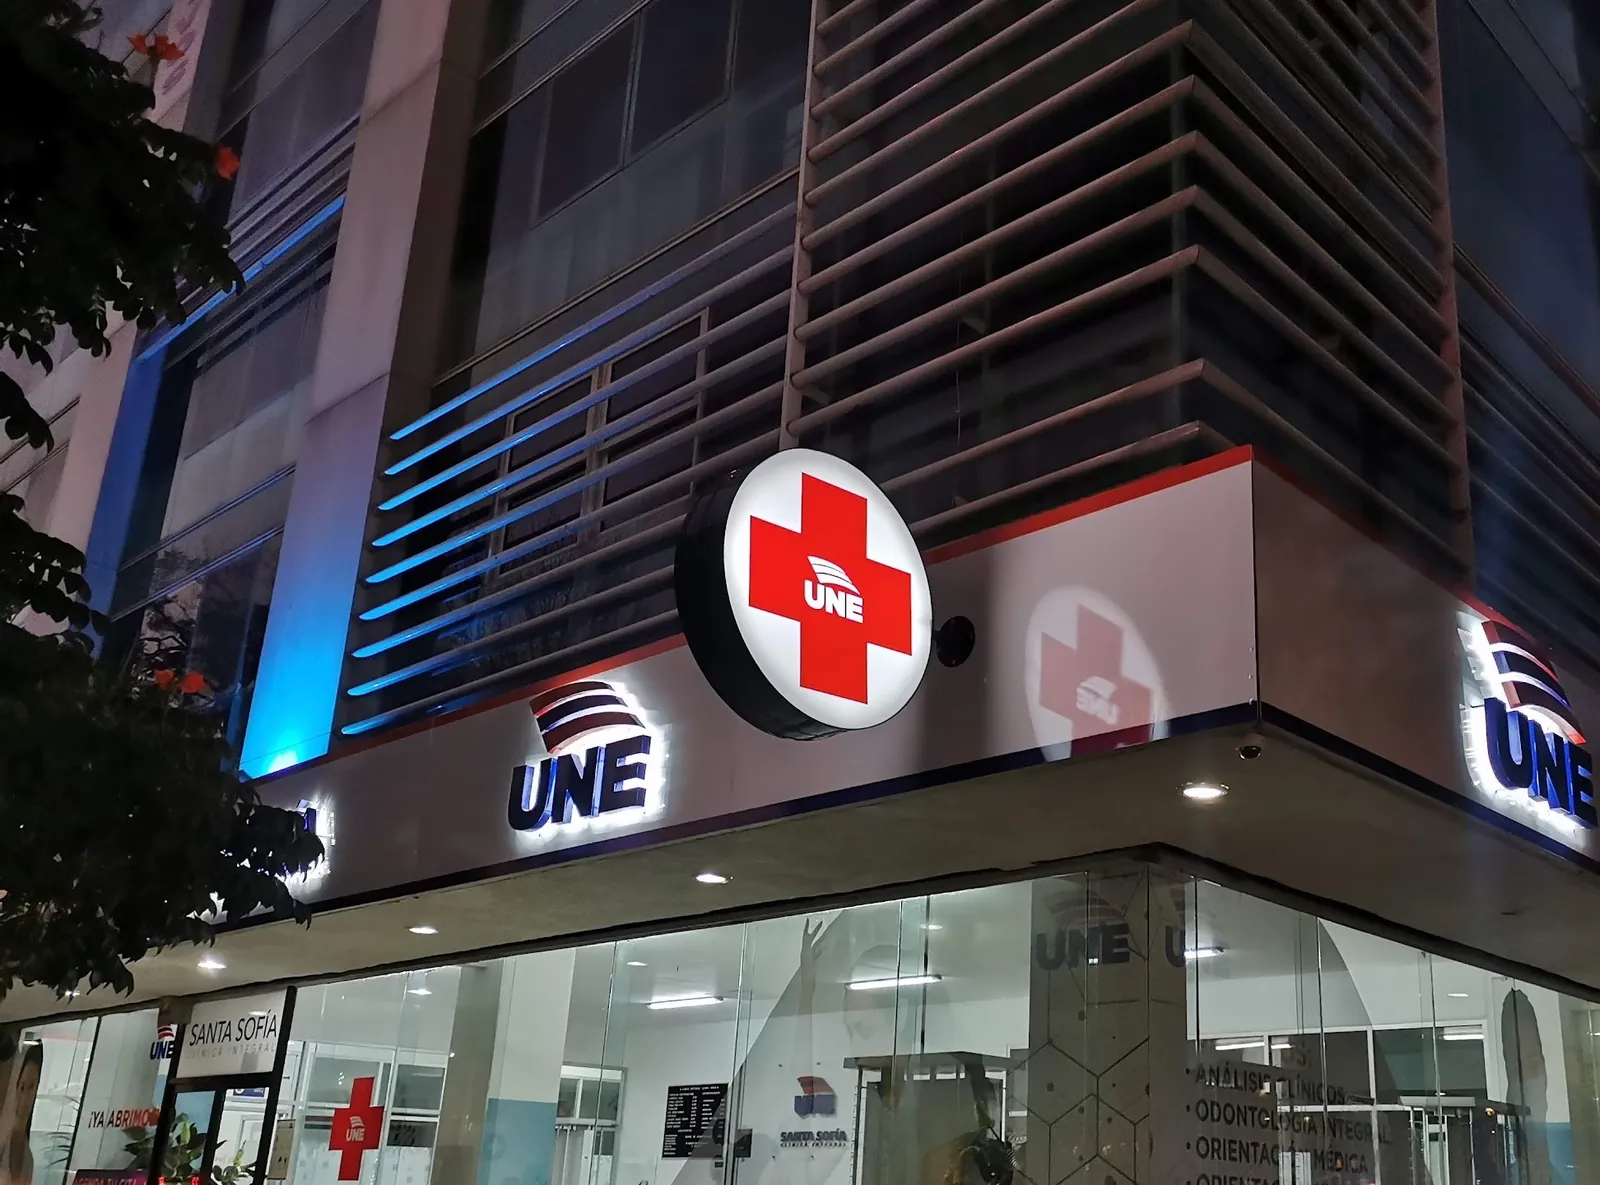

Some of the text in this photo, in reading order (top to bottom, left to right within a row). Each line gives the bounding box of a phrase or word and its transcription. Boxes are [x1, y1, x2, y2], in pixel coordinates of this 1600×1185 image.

[803, 579, 864, 624] UNE
[507, 735, 652, 831] UNE
[1484, 697, 1599, 830] UNE
[1036, 923, 1130, 970] UNE
[189, 1009, 277, 1046] SANTA SOFÍA
[150, 1040, 176, 1061] UNE
[345, 1128, 366, 1142] UNE
[1196, 1136, 1368, 1173] ORIENTAC MÉDICA
